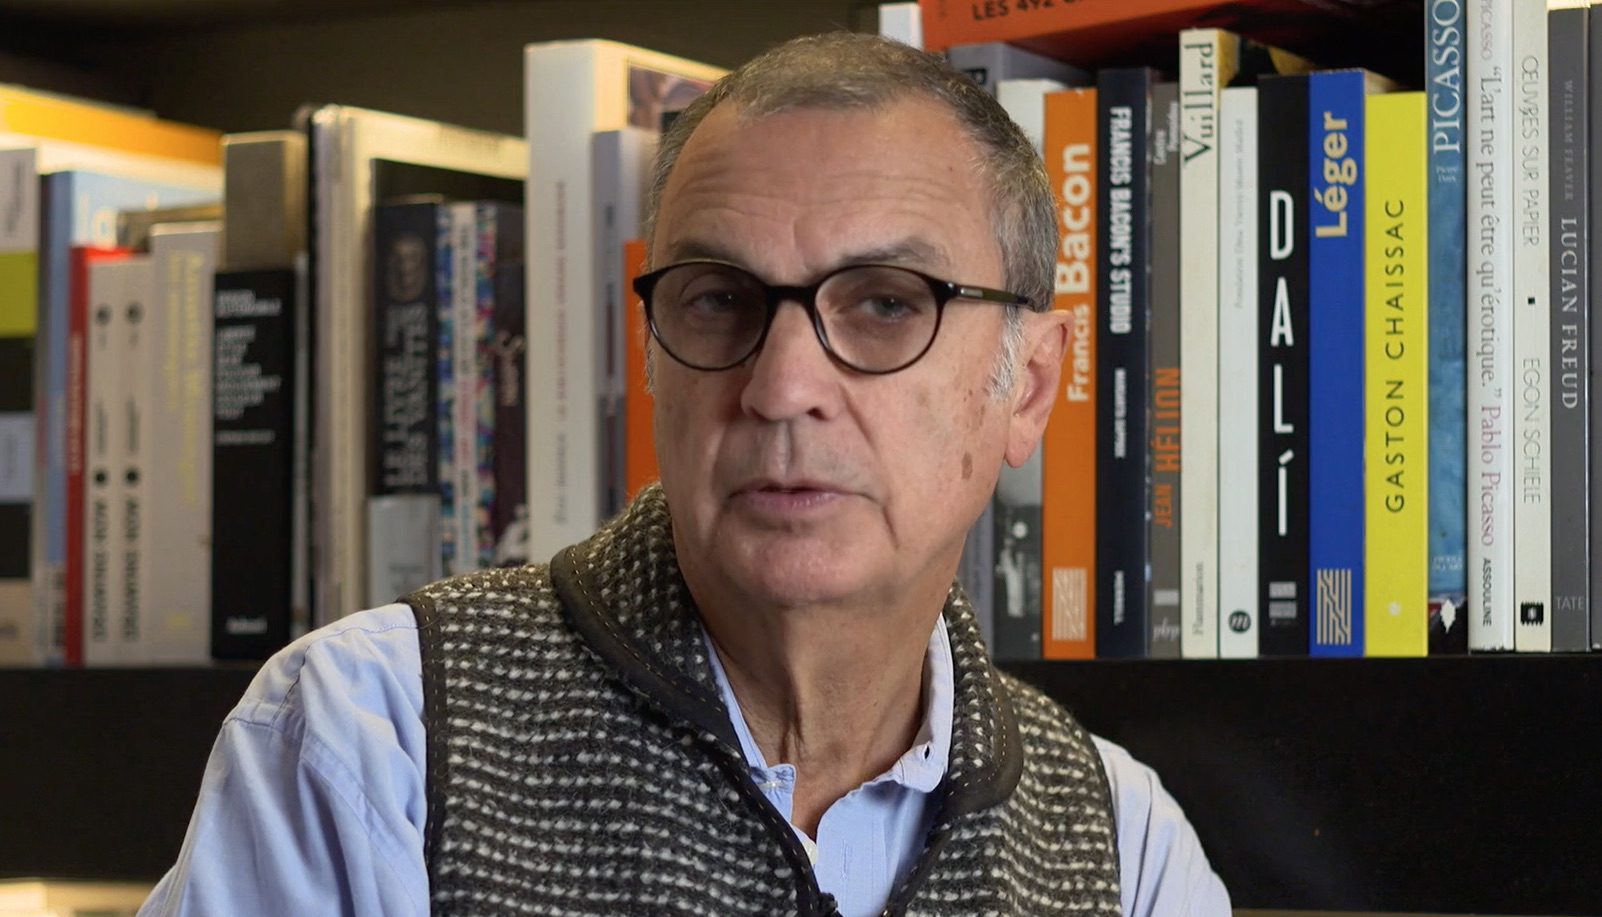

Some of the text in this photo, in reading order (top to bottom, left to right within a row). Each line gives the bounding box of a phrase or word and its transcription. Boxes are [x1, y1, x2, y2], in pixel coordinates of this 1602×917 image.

[972, 0, 1008, 20] LES
[1182, 42, 1213, 167] Vuillard
[1432, 0, 1461, 154] PICASSO
[1109, 106, 1132, 185] FRANCIS
[1313, 111, 1358, 238] Léger
[1481, 129, 1494, 156] ne
[1521, 147, 1539, 182] SUR
[1564, 79, 1574, 200] WILLIAM FEAVER
[1476, 161, 1495, 209] peut
[1522, 188, 1540, 247] PAPIER
[1480, 213, 1500, 256] être
[1054, 143, 1091, 402] Francis Bacon
[1109, 268, 1132, 334] STUDIO
[1560, 217, 1578, 409] LUCIAN FREUD
[1385, 199, 1405, 513] GASTON CHAISSAC
[1481, 405, 1501, 465] Pablo
[1522, 357, 1541, 505] EGON SCHIELE
[1154, 484, 1173, 529] JEAN
[1481, 471, 1501, 547] Picasso
[1482, 557, 1492, 627] ASSOULINE
[1556, 596, 1585, 610] TATE
